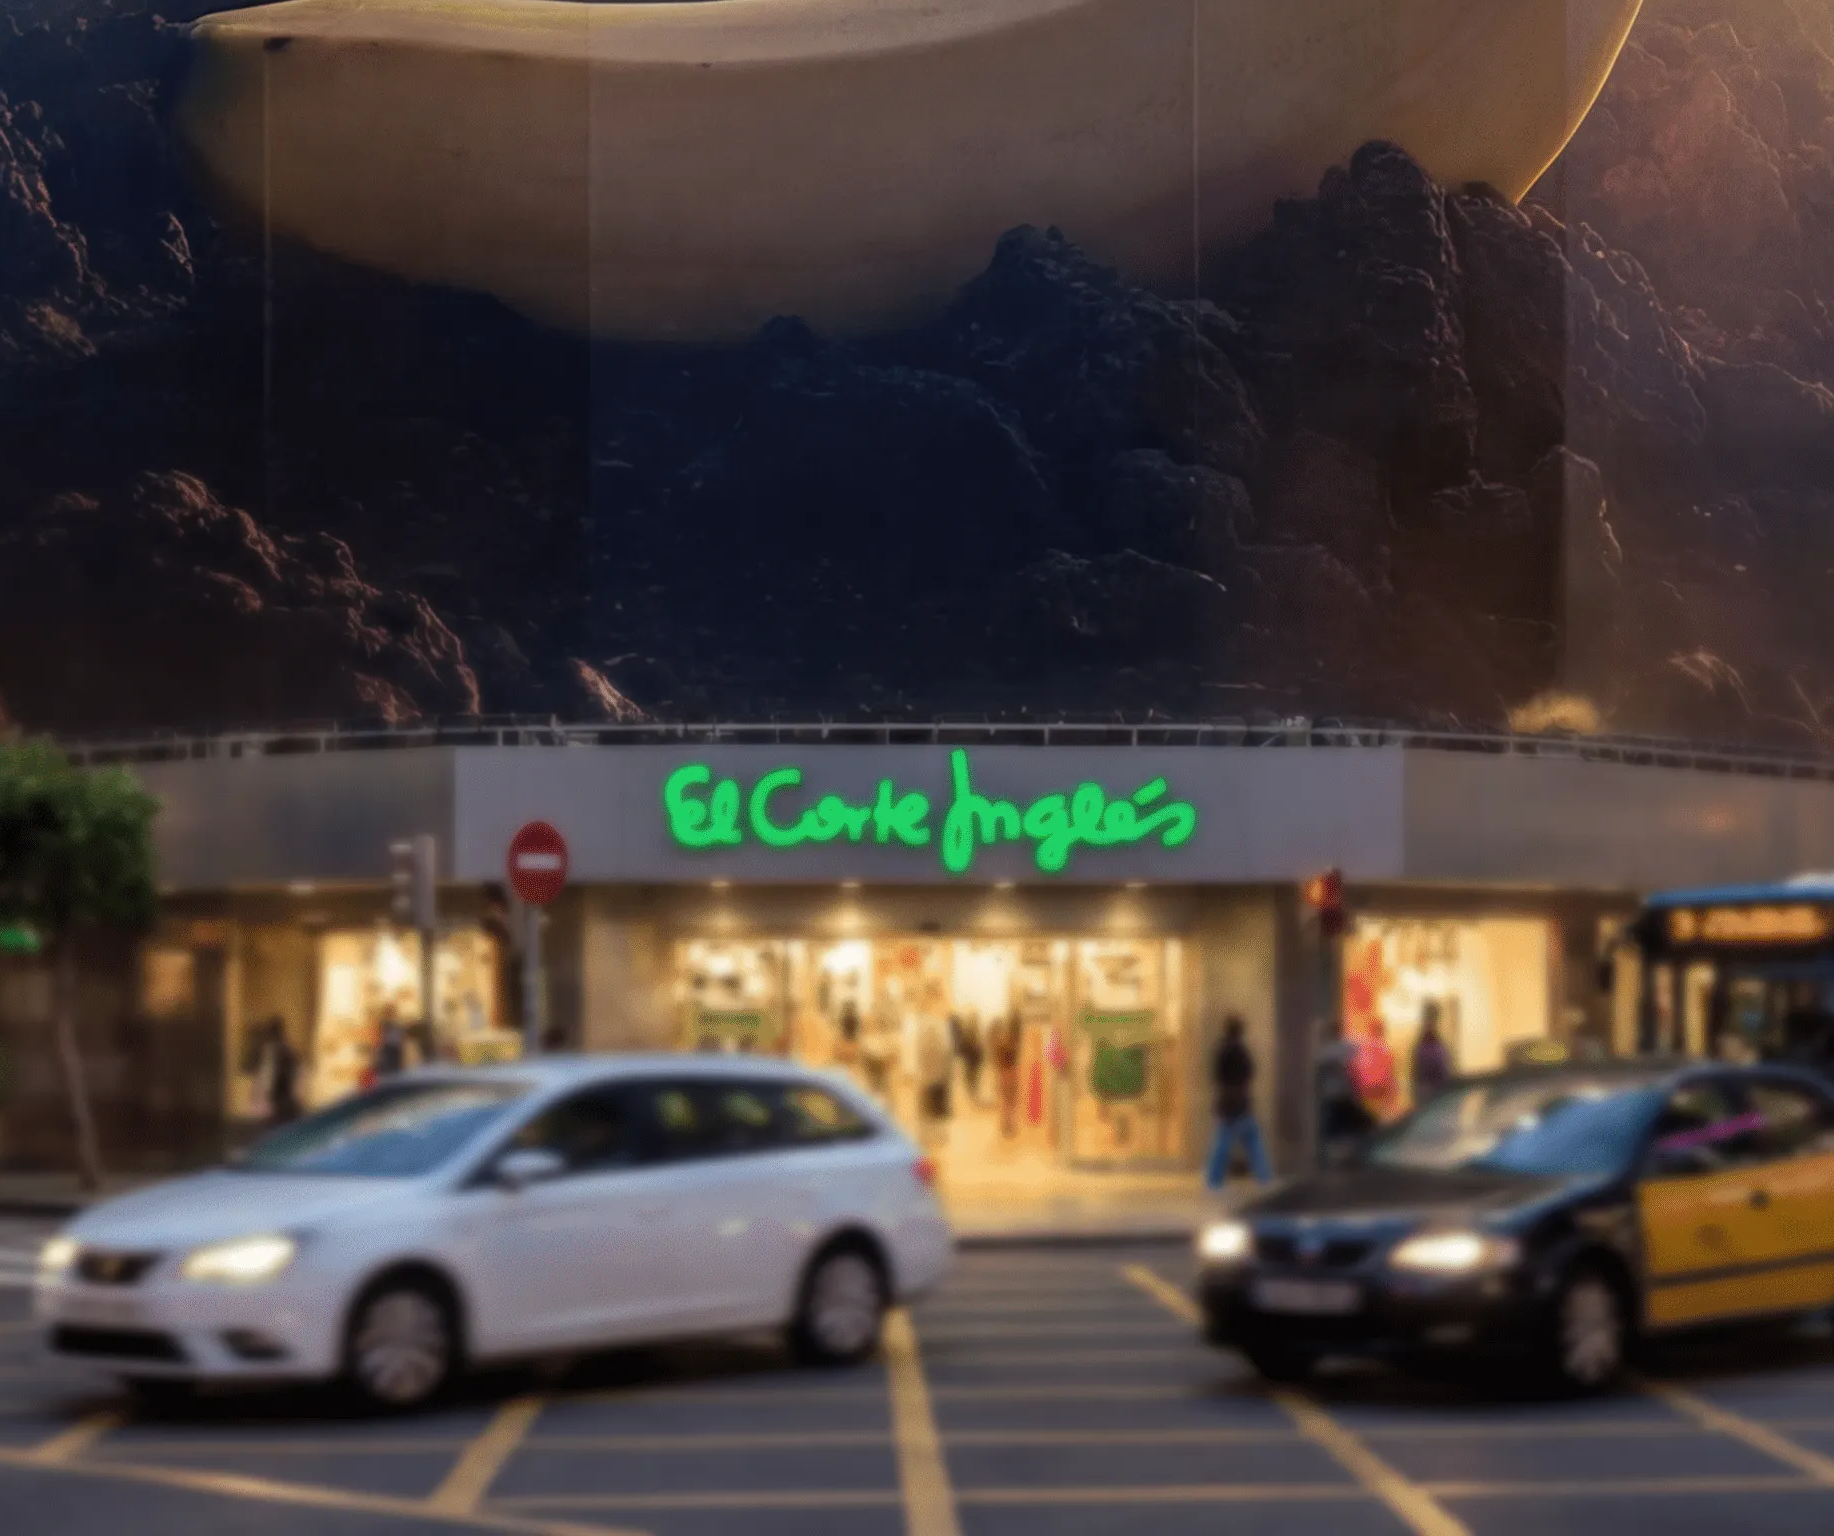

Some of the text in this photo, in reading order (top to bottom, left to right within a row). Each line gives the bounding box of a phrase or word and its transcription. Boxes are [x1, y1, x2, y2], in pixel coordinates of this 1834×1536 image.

[663, 747, 1197, 873] El Corte Inglés
